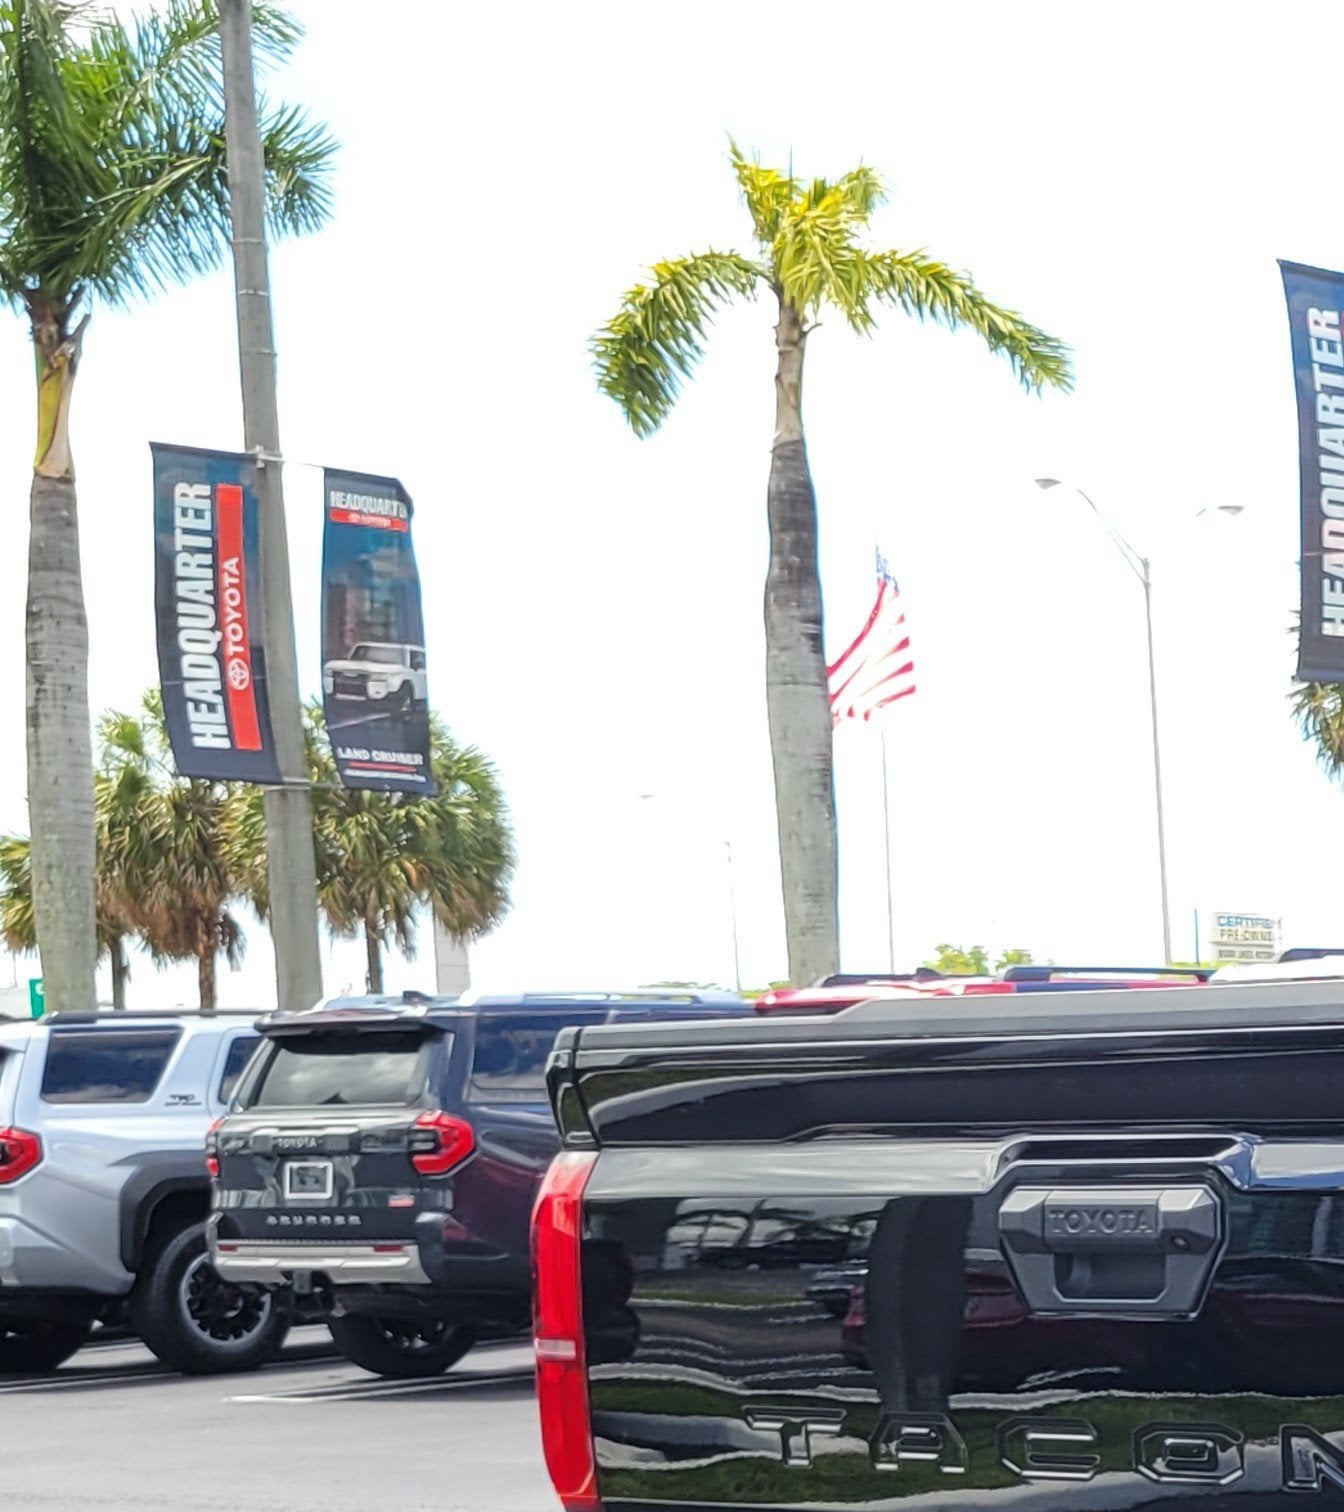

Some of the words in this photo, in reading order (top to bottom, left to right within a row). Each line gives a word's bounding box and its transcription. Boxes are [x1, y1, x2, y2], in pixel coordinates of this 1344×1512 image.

[174, 482, 231, 749] HEADQUARTER
[223, 556, 244, 656] TOYOTA
[337, 747, 370, 760] LAND
[1217, 915, 1274, 929] CERTIFIE
[1220, 928, 1273, 941] PRE-OWNE
[1049, 1209, 1153, 1234] TOYOTA
